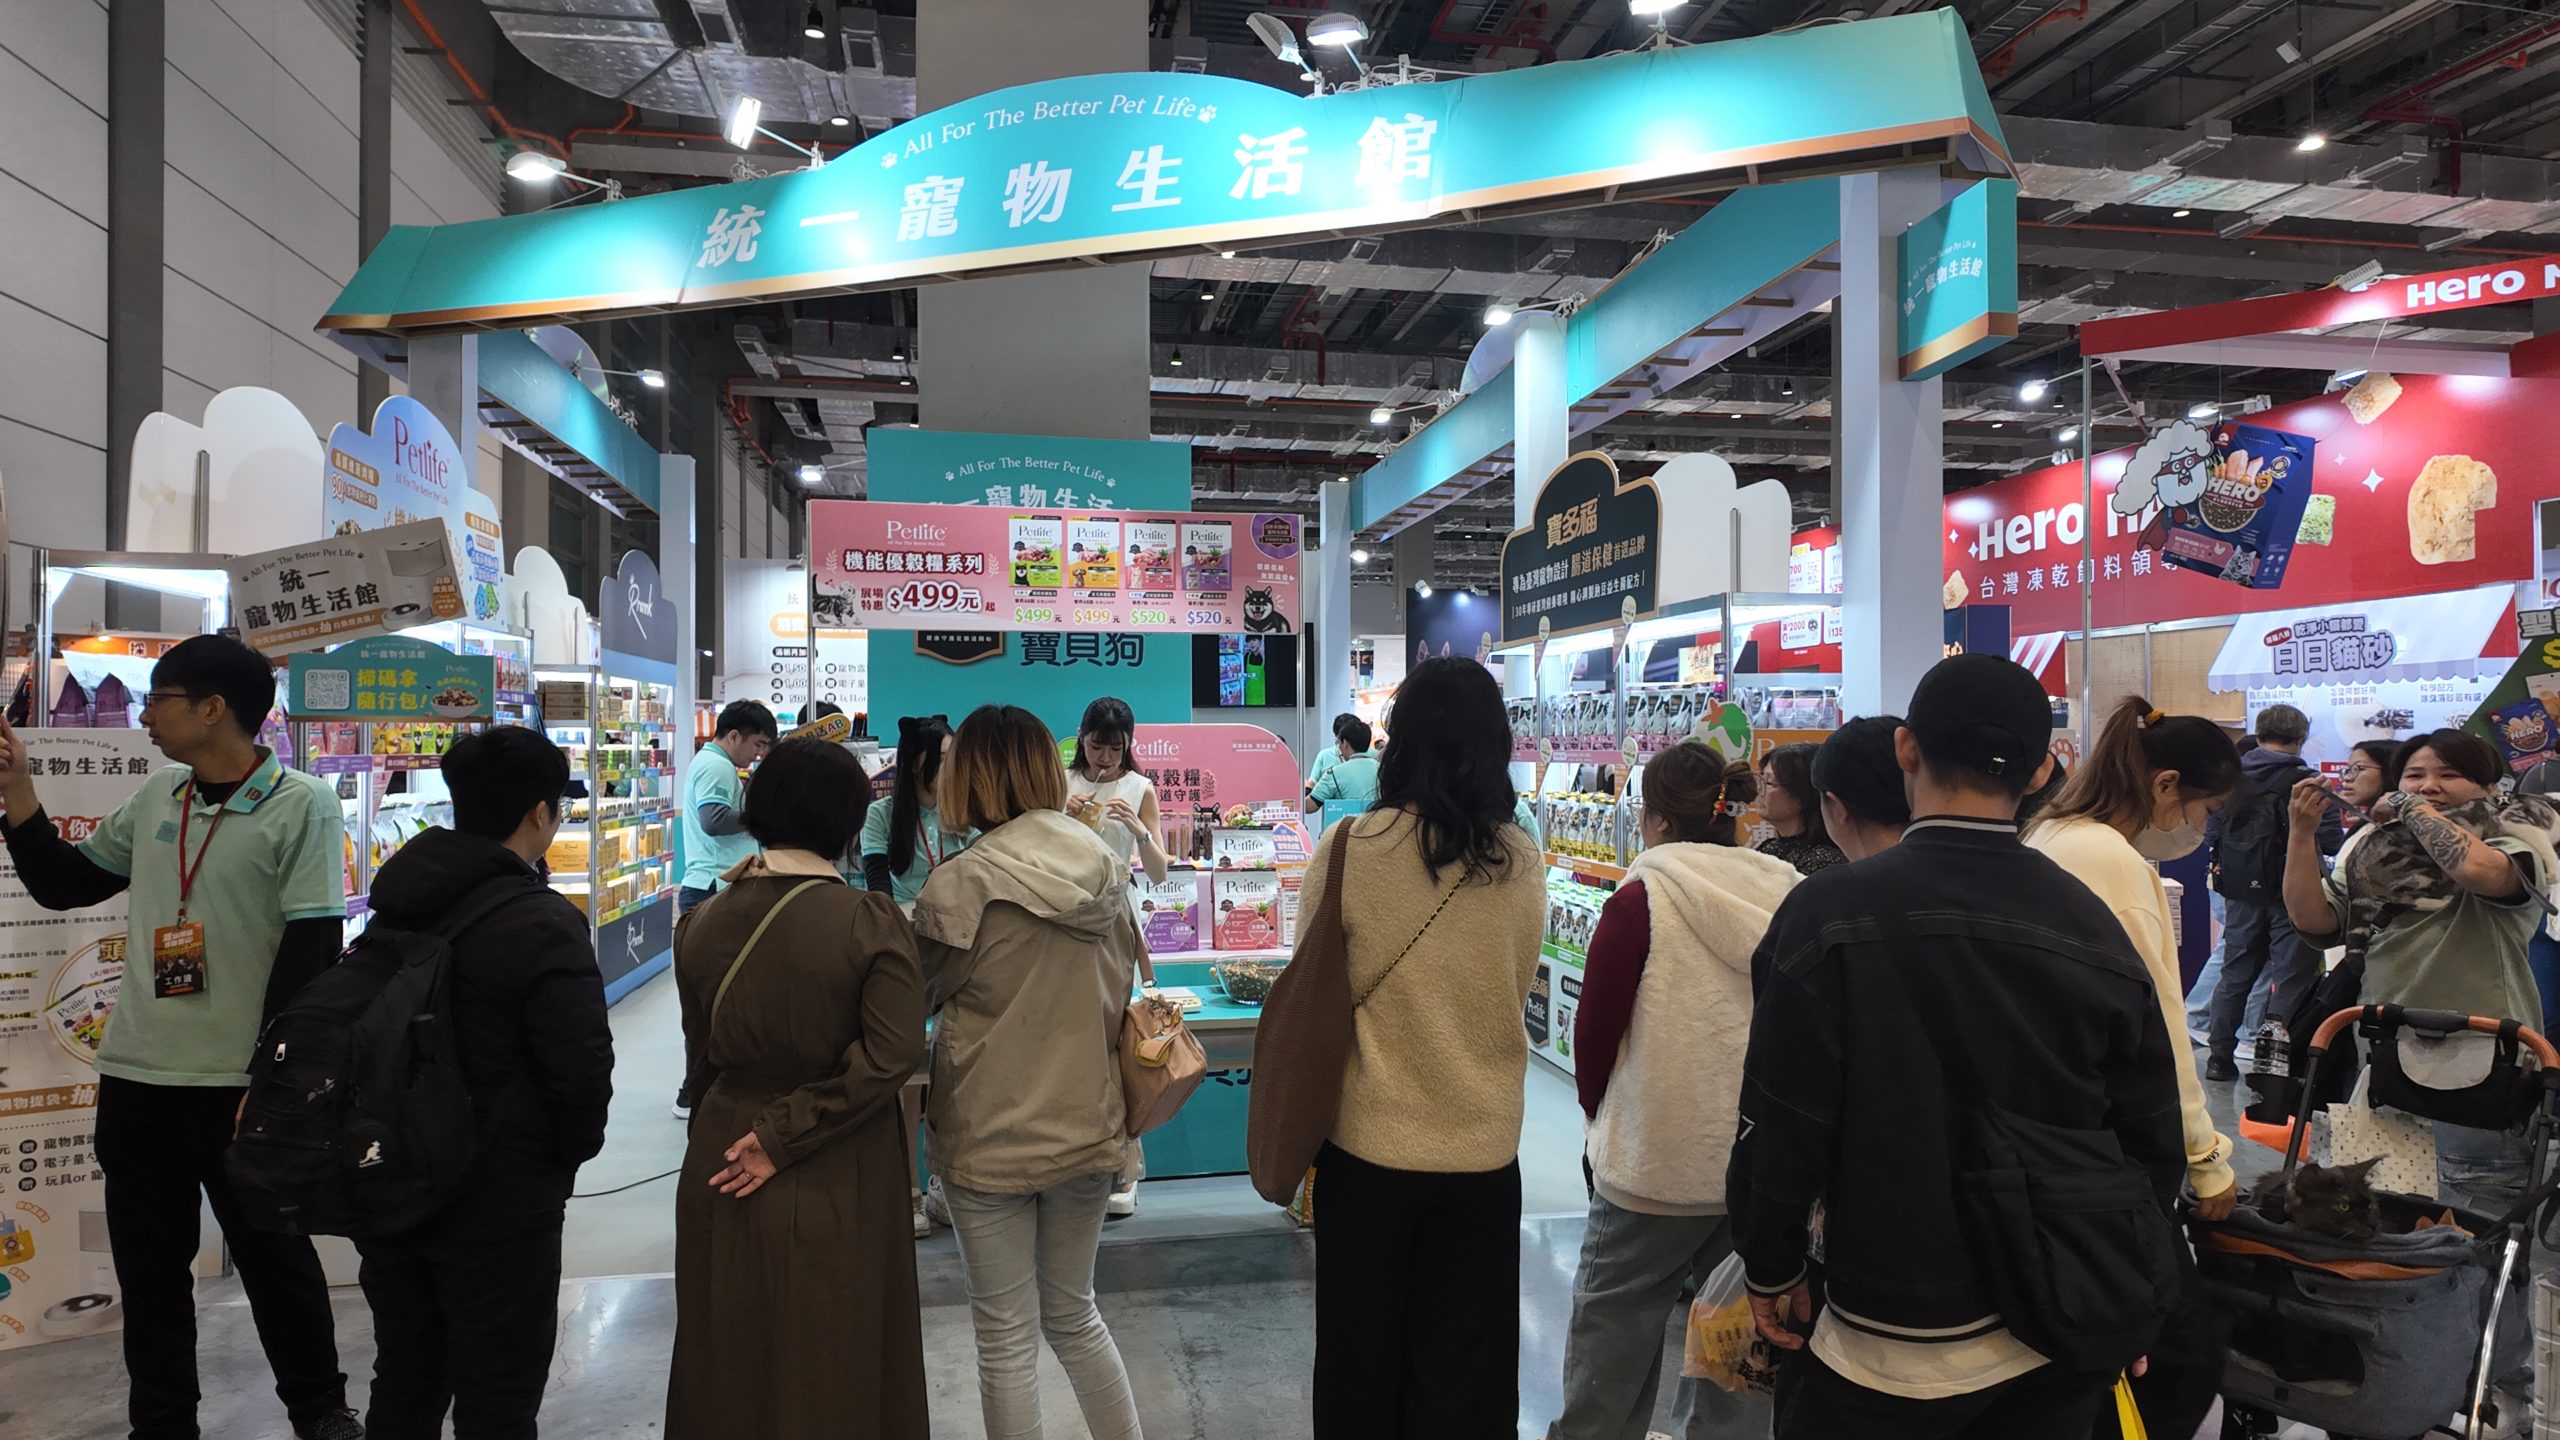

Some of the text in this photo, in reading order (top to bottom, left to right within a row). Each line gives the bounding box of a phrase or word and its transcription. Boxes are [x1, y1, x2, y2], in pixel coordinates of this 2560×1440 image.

[903, 94, 1197, 158] All For The Better Pet Life
[696, 113, 1437, 269] 統一寵物生活館
[2407, 270, 2526, 308] Hero
[394, 416, 448, 489] Petlife
[959, 456, 1105, 482] All For The Better Pet Life
[930, 484, 1120, 510] 一寵物生活
[2207, 477, 2260, 502] HERO
[887, 520, 946, 540] Petlife
[1019, 525, 1052, 537] Petlife
[1077, 527, 1110, 539] Petlife
[1547, 498, 1598, 549] 寶多福
[1979, 503, 2084, 561] Hero
[1134, 529, 1167, 540] Petlife
[1191, 530, 1223, 541] Petlife
[250, 548, 355, 578] All For The Better Pet Life
[844, 550, 983, 573] 機能優穀糧系列
[279, 568, 330, 594] 統一
[861, 588, 884, 599] 展場
[244, 582, 381, 630] 寵物生活館
[861, 600, 884, 611] 特惠
[985, 601, 995, 612] 起
[1015, 608, 1062, 623] $499 元
[1075, 609, 1120, 624] $499 元
[1131, 610, 1176, 624] $520 元
[1188, 611, 1232, 625] $520 元
[2519, 607, 2560, 638] 聖
[1021, 632, 1144, 667] 寶貝狗
[2274, 632, 2393, 675] 日日貓砂
[357, 668, 418, 688] 掃碼拿
[357, 691, 428, 710] 隨行包!
[2510, 726, 2543, 740] HERO
[38, 737, 53, 745] The
[56, 737, 79, 745] Better
[82, 738, 94, 746] Pet
[97, 740, 111, 750] Life
[1225, 838, 1263, 851] Petlife
[1146, 881, 1185, 894] Petlife
[1227, 881, 1265, 893] Petlife
[164, 974, 192, 986] 工作證
[44, 1173, 87, 1187] 玩具or
